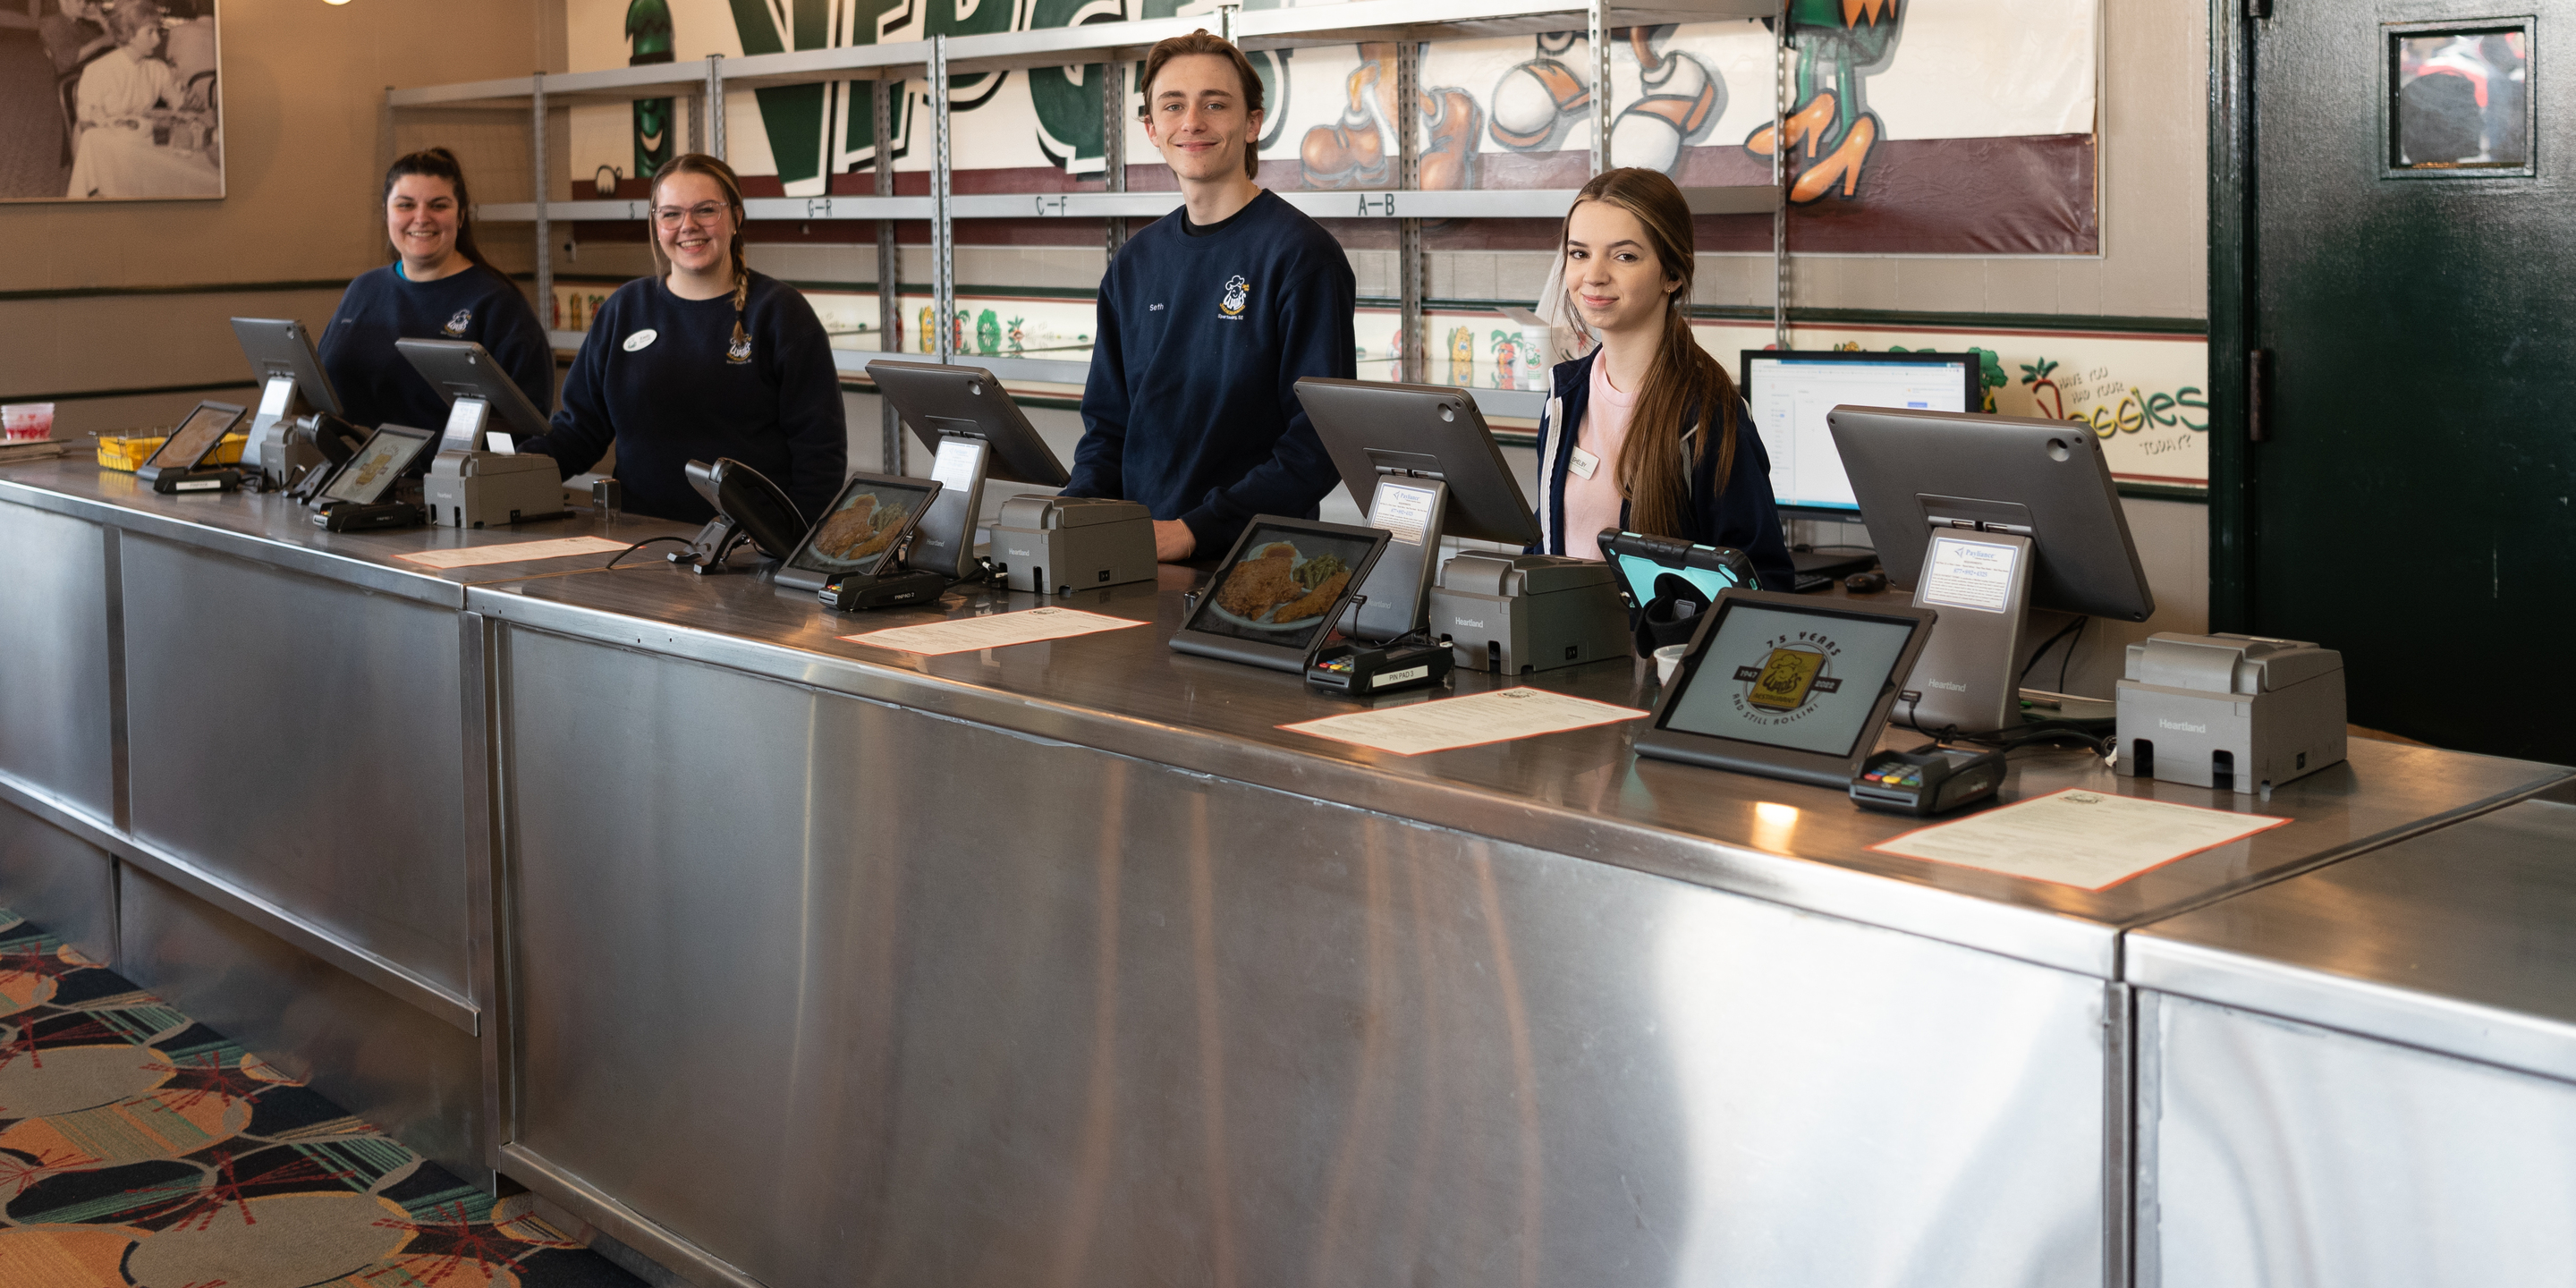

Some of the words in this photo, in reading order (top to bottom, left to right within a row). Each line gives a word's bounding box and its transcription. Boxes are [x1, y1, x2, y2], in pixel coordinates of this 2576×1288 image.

[808, 199, 832, 218] G-R
[1036, 196, 1068, 216] C-F
[1358, 193, 1396, 217] A-B
[1149, 302, 1165, 312] Seth
[2059, 372, 2083, 390] HAVE
[2089, 366, 2108, 383] YOU
[2072, 388, 2090, 404] HAD
[2097, 381, 2124, 399] YOUR
[2139, 434, 2191, 455] TODAY?
[927, 538, 945, 547] Heartland
[1008, 547, 1030, 556] Heartland
[1966, 549, 1995, 558] Payliance
[1455, 616, 1484, 629] Heartland
[1766, 634, 1786, 648] 75
[1799, 631, 1842, 657] YEARS
[1398, 672, 1410, 680] PAD
[1740, 669, 1758, 679] 1947
[1928, 678, 1967, 693] Heartland
[1732, 693, 1744, 711] AND
[1743, 711, 1767, 725] STILL
[2159, 718, 2207, 733] Heartland
